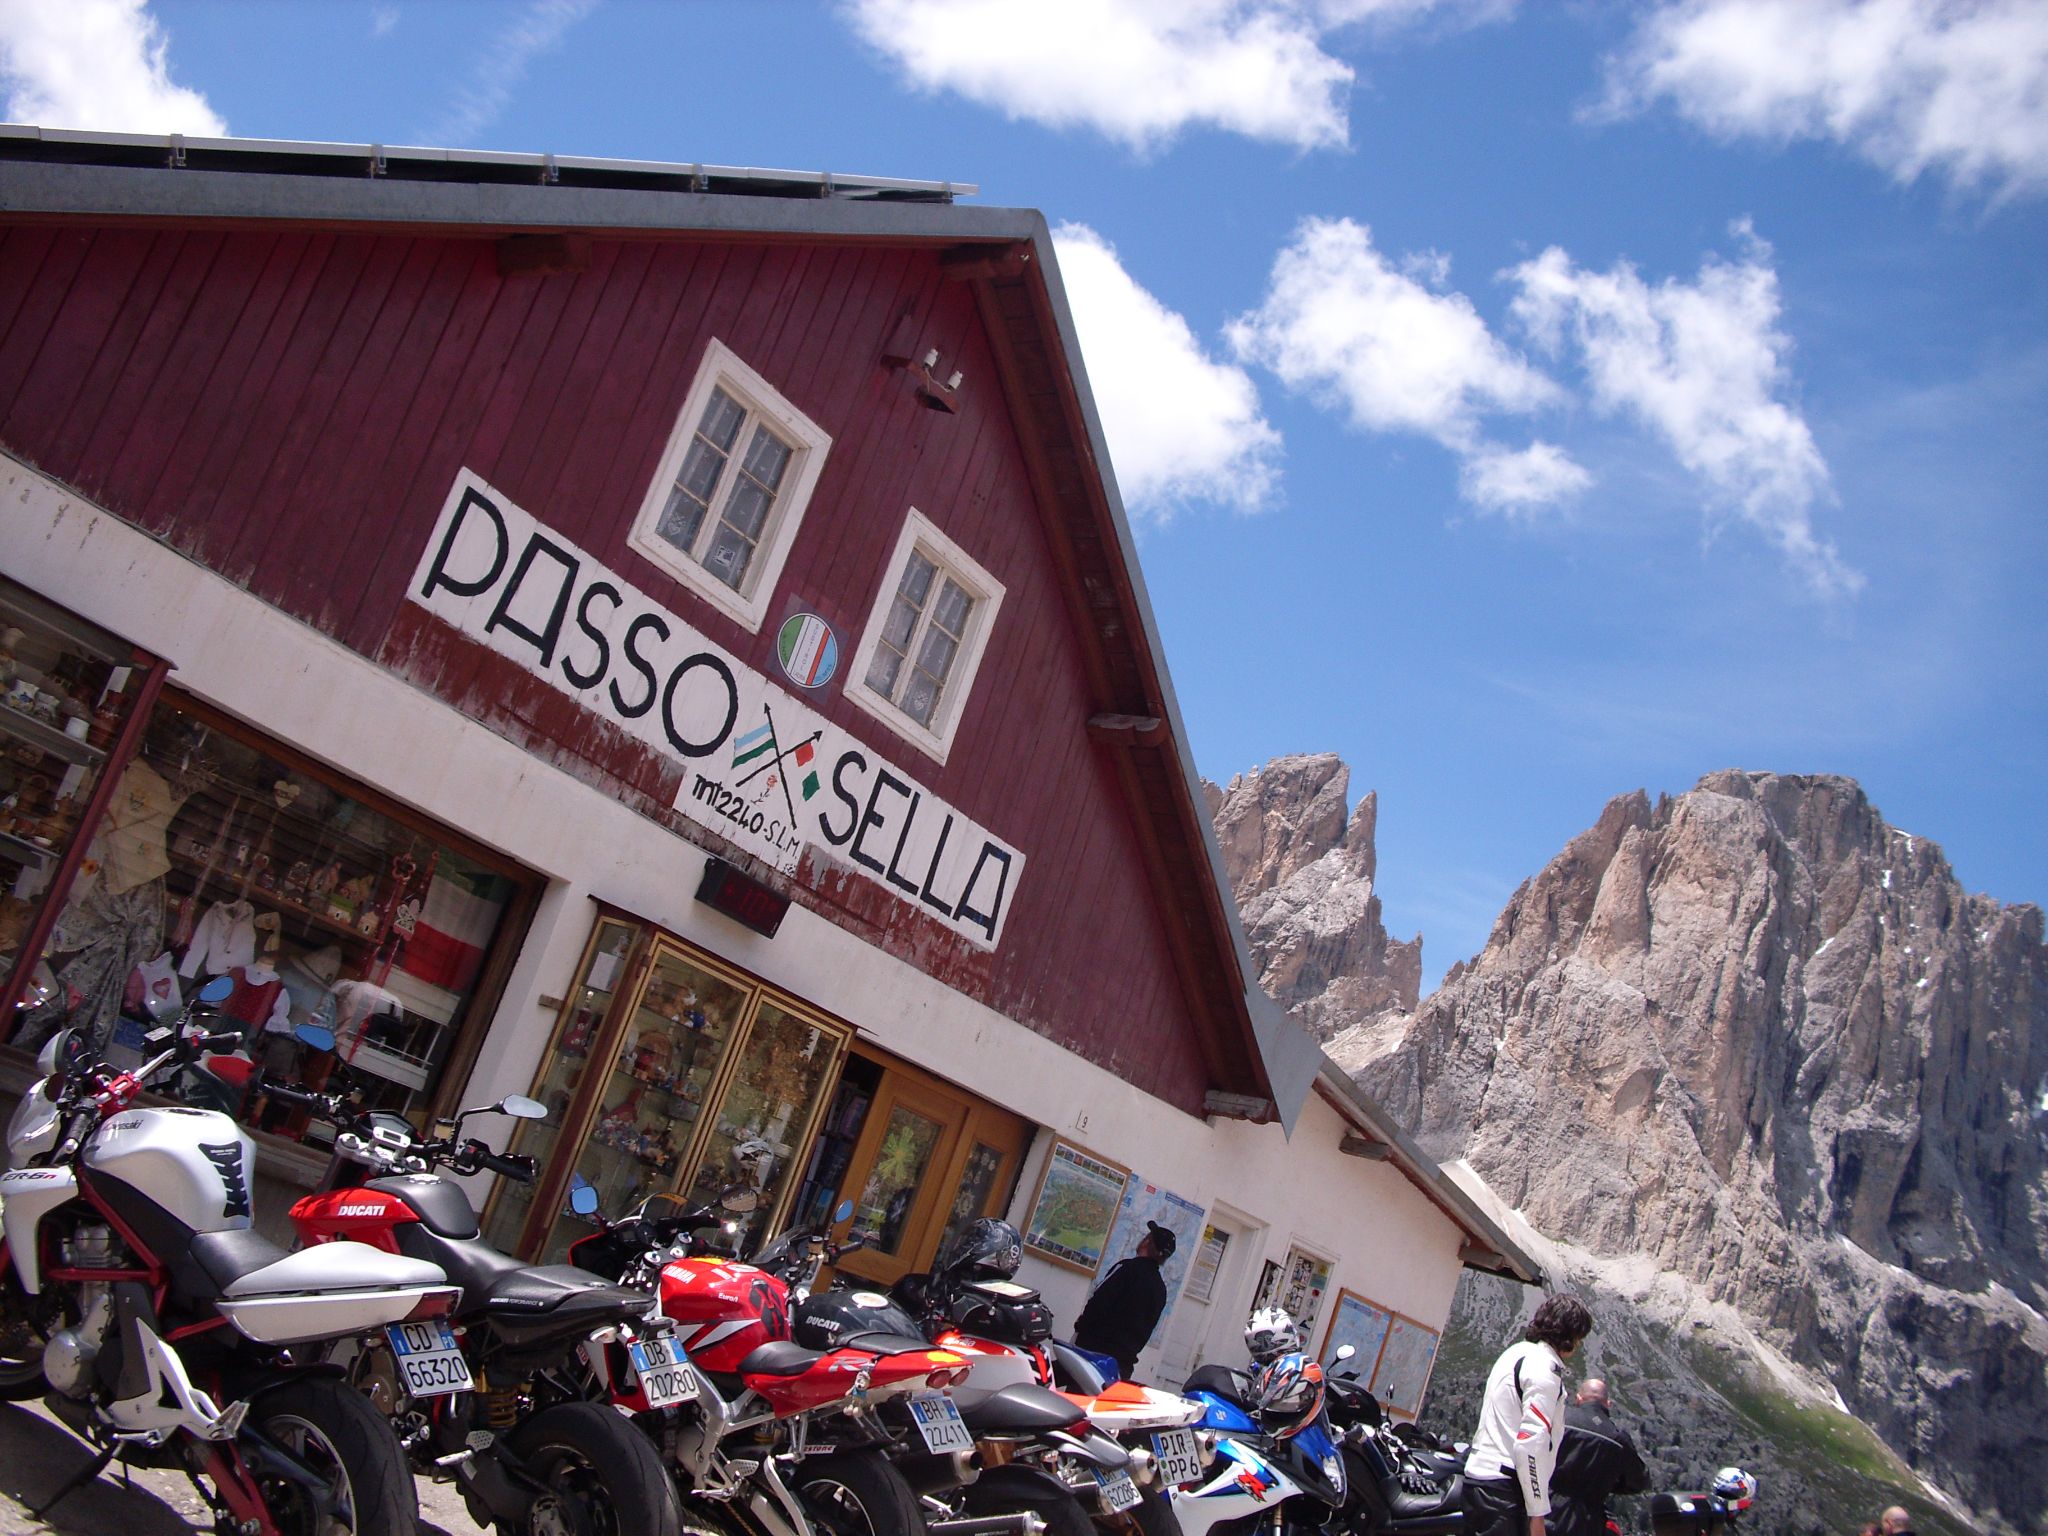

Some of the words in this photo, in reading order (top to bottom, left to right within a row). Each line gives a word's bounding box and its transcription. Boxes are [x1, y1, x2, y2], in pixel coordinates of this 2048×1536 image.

[421, 486, 738, 757] PASSO
[819, 751, 1012, 941] SELLA
[337, 1205, 386, 1217] DUCATI
[806, 1315, 840, 1332] DUCATI
[404, 1324, 433, 1351] CD
[643, 1342, 667, 1366] DB
[406, 1356, 468, 1388] 66320
[645, 1369, 696, 1401] 20280
[920, 1400, 943, 1421] BH
[925, 1424, 969, 1447] 22411
[1160, 1433, 1187, 1457] PIR
[1168, 1458, 1187, 1480] PP
[1190, 1455, 1199, 1476] 6
[1106, 1481, 1140, 1507] 62286
